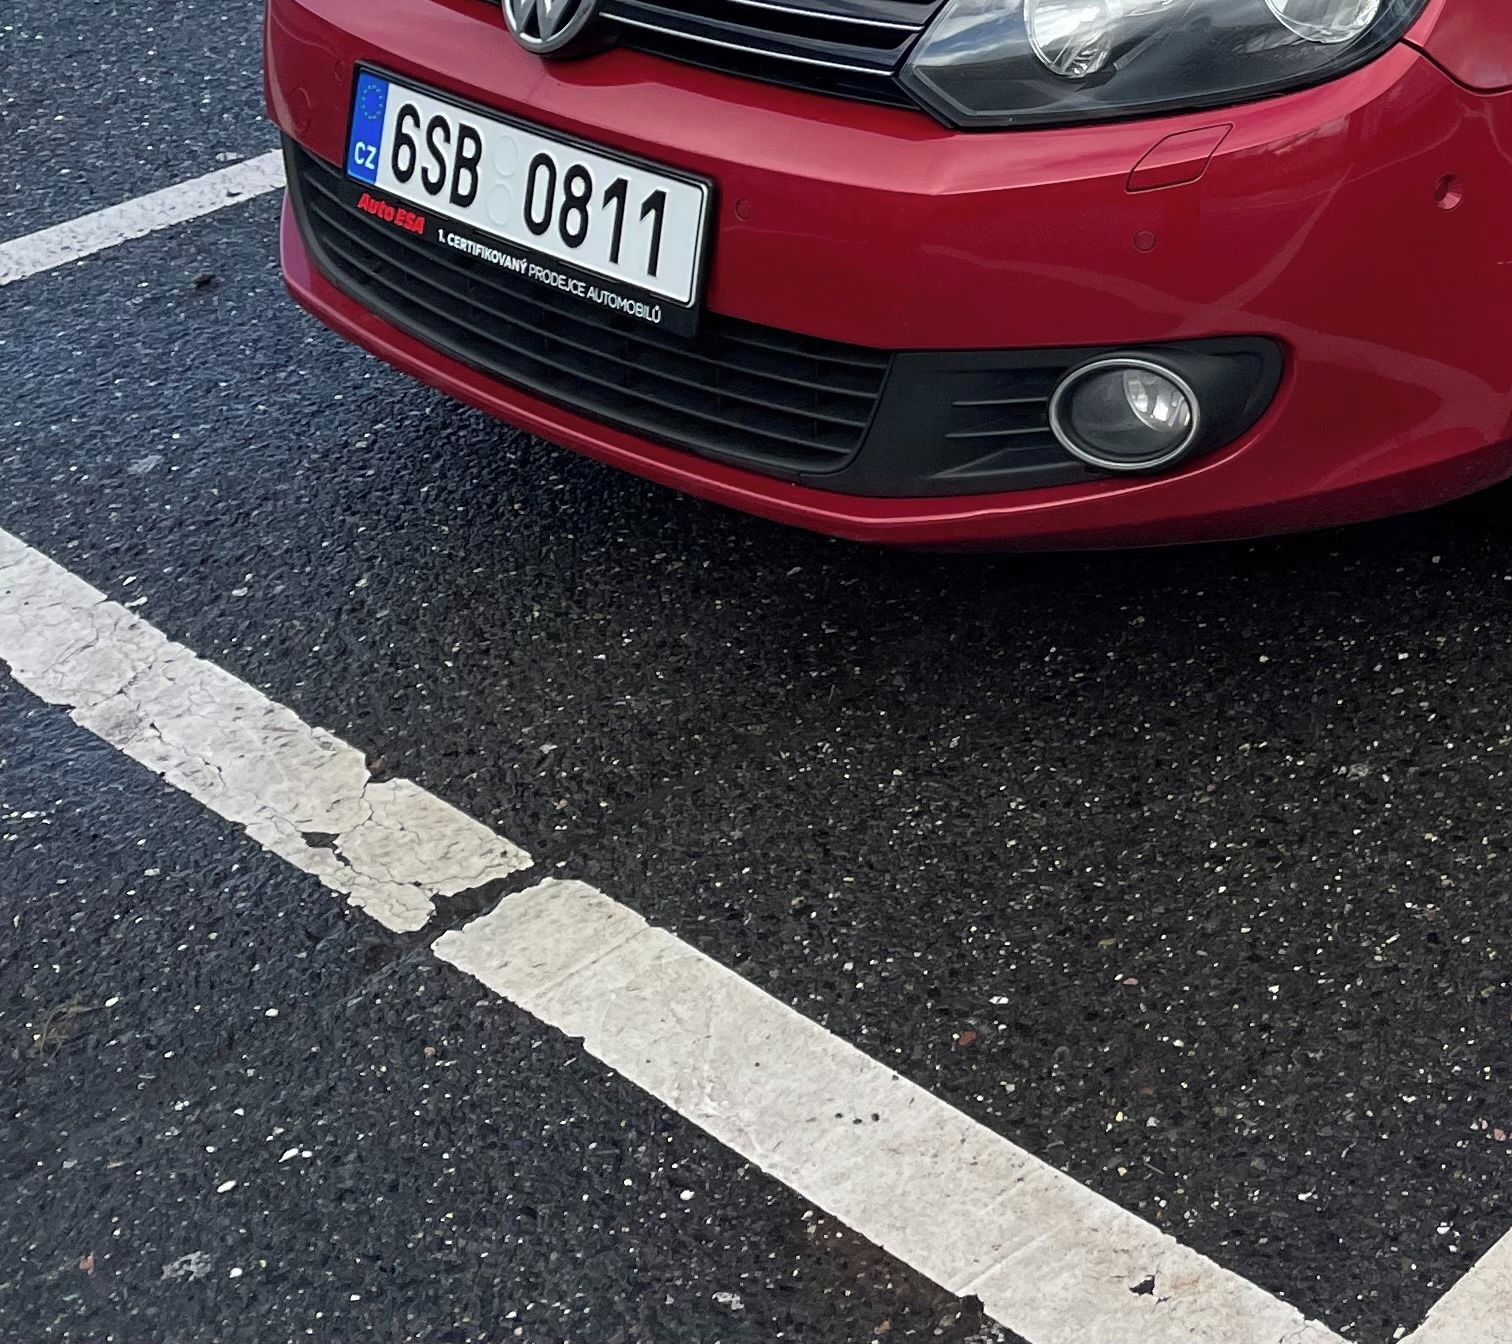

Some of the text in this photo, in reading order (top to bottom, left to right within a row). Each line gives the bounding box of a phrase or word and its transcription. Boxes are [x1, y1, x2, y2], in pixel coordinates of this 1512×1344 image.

[354, 141, 377, 170] CZ
[357, 192, 426, 235] Auto ESA
[391, 103, 667, 278] 6SB 0811
[438, 228, 661, 324] 1. CERTIFIKOVANÝ PRODEJCE AUTOMOBILŮ
